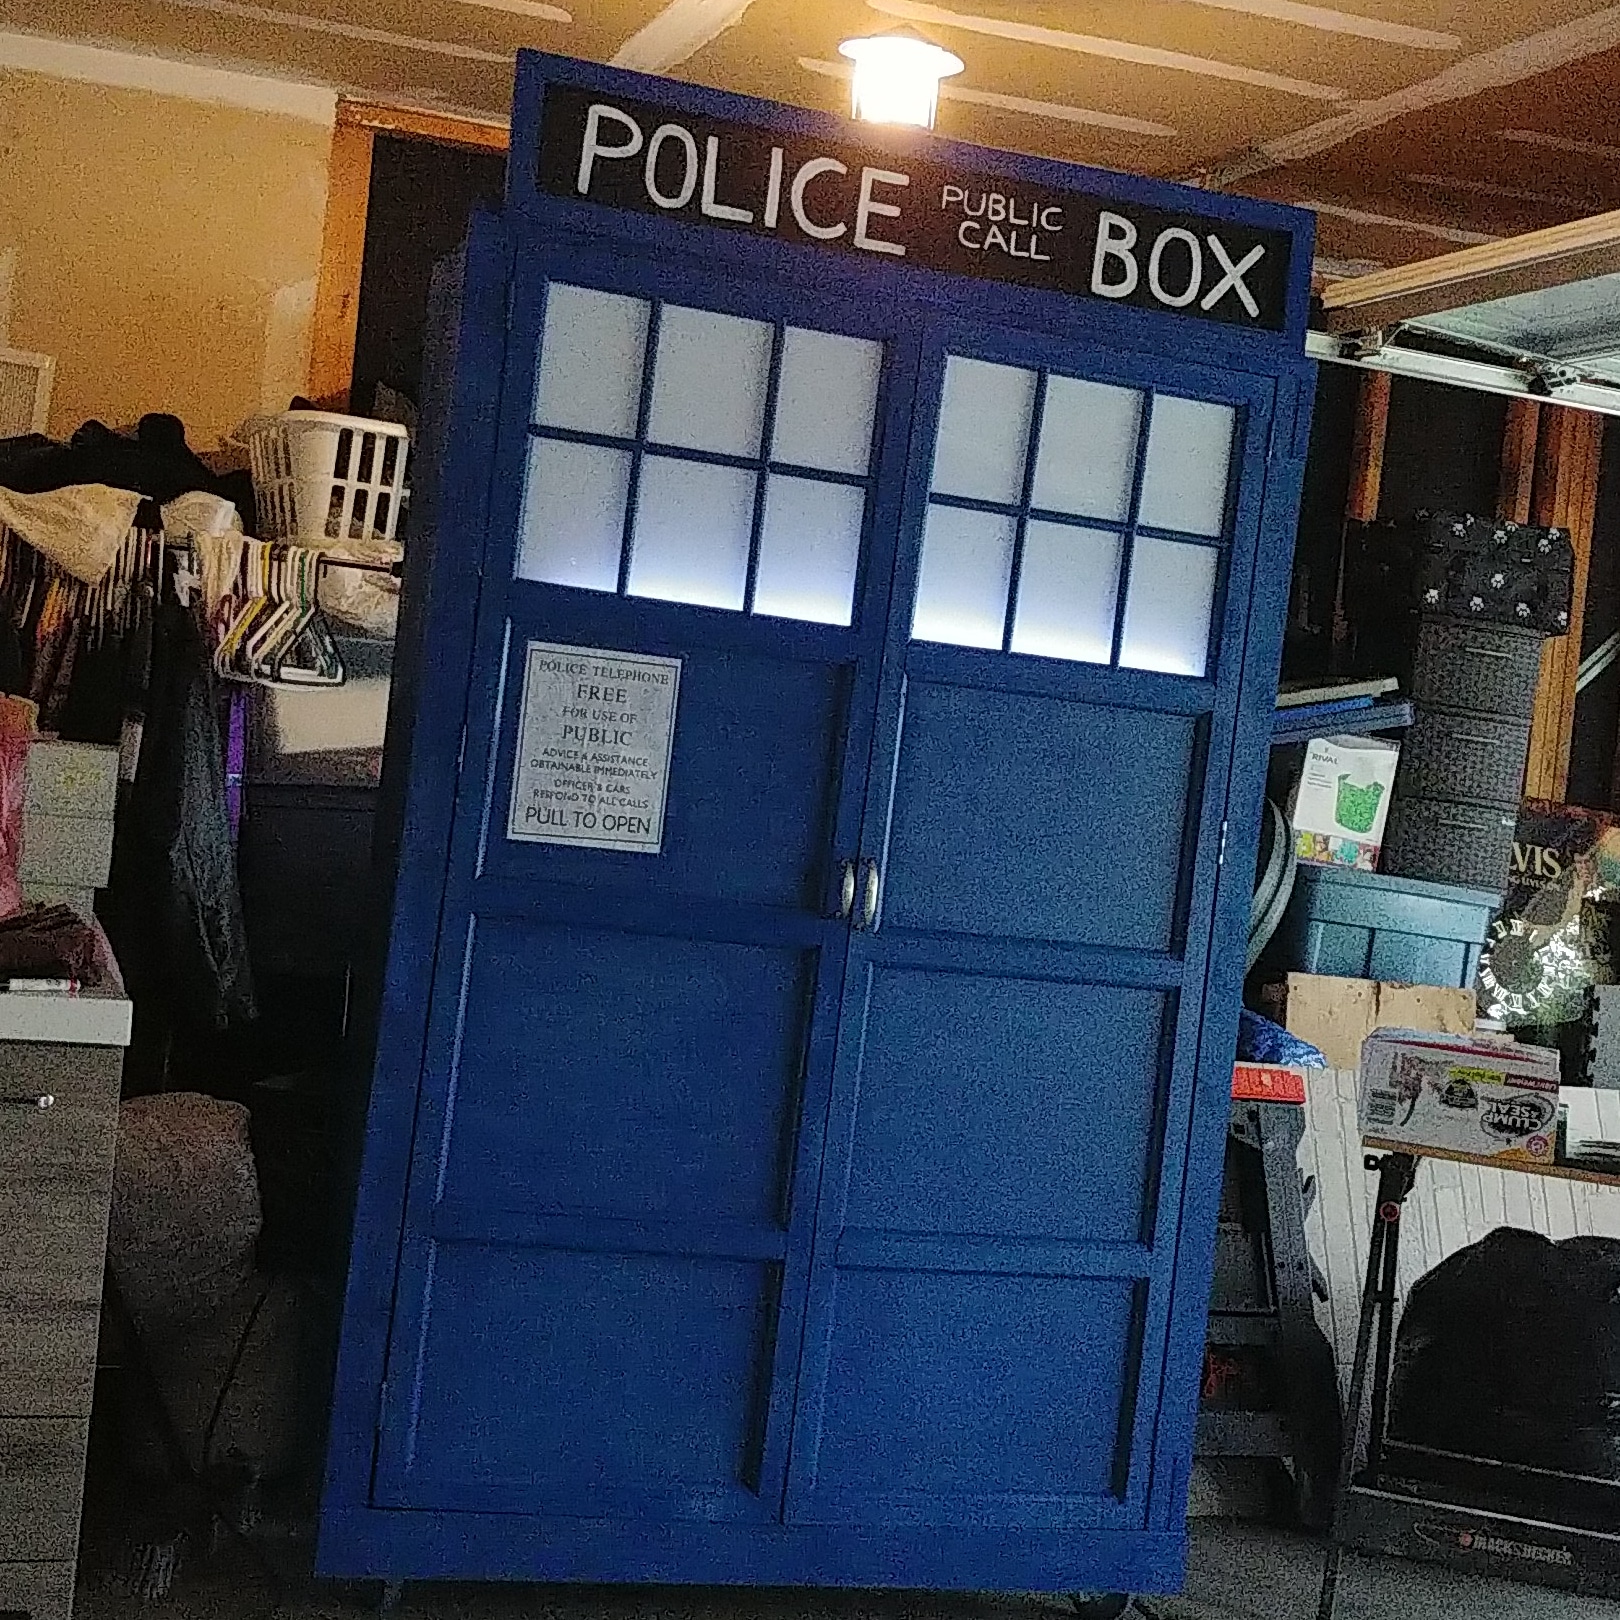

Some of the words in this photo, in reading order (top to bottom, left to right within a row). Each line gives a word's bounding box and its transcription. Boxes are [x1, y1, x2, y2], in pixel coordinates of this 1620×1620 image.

[577, 104, 910, 256] POLICE
[942, 185, 1063, 232] PUBLIC
[958, 221, 1050, 261] CALL
[1091, 211, 1266, 317] BOX
[539, 659, 587, 675] POLICE
[593, 666, 669, 685] TELEPHONE
[577, 684, 627, 704] FREE
[562, 705, 588, 719] FOR
[592, 709, 617, 722] USE
[620, 713, 638, 724] OF
[562, 725, 633, 746] PUBLIC
[542, 747, 579, 760] ADVICE
[591, 753, 649, 767] ASSISTANCE
[1311, 753, 1339, 765] RIVAL
[530, 758, 591, 774] OBTAINABLE
[594, 766, 658, 780] IMMEDIATELY
[605, 784, 631, 795] CARS
[581, 794, 596, 804] TO
[619, 798, 649, 809] CALLS
[525, 805, 568, 827] PULL
[573, 811, 597, 829] TO
[602, 814, 651, 835] OPEN
[1510, 841, 1561, 879] VIS
[1488, 1101, 1531, 1118] SEAL
[1483, 1111, 1542, 1131] CLUMP
